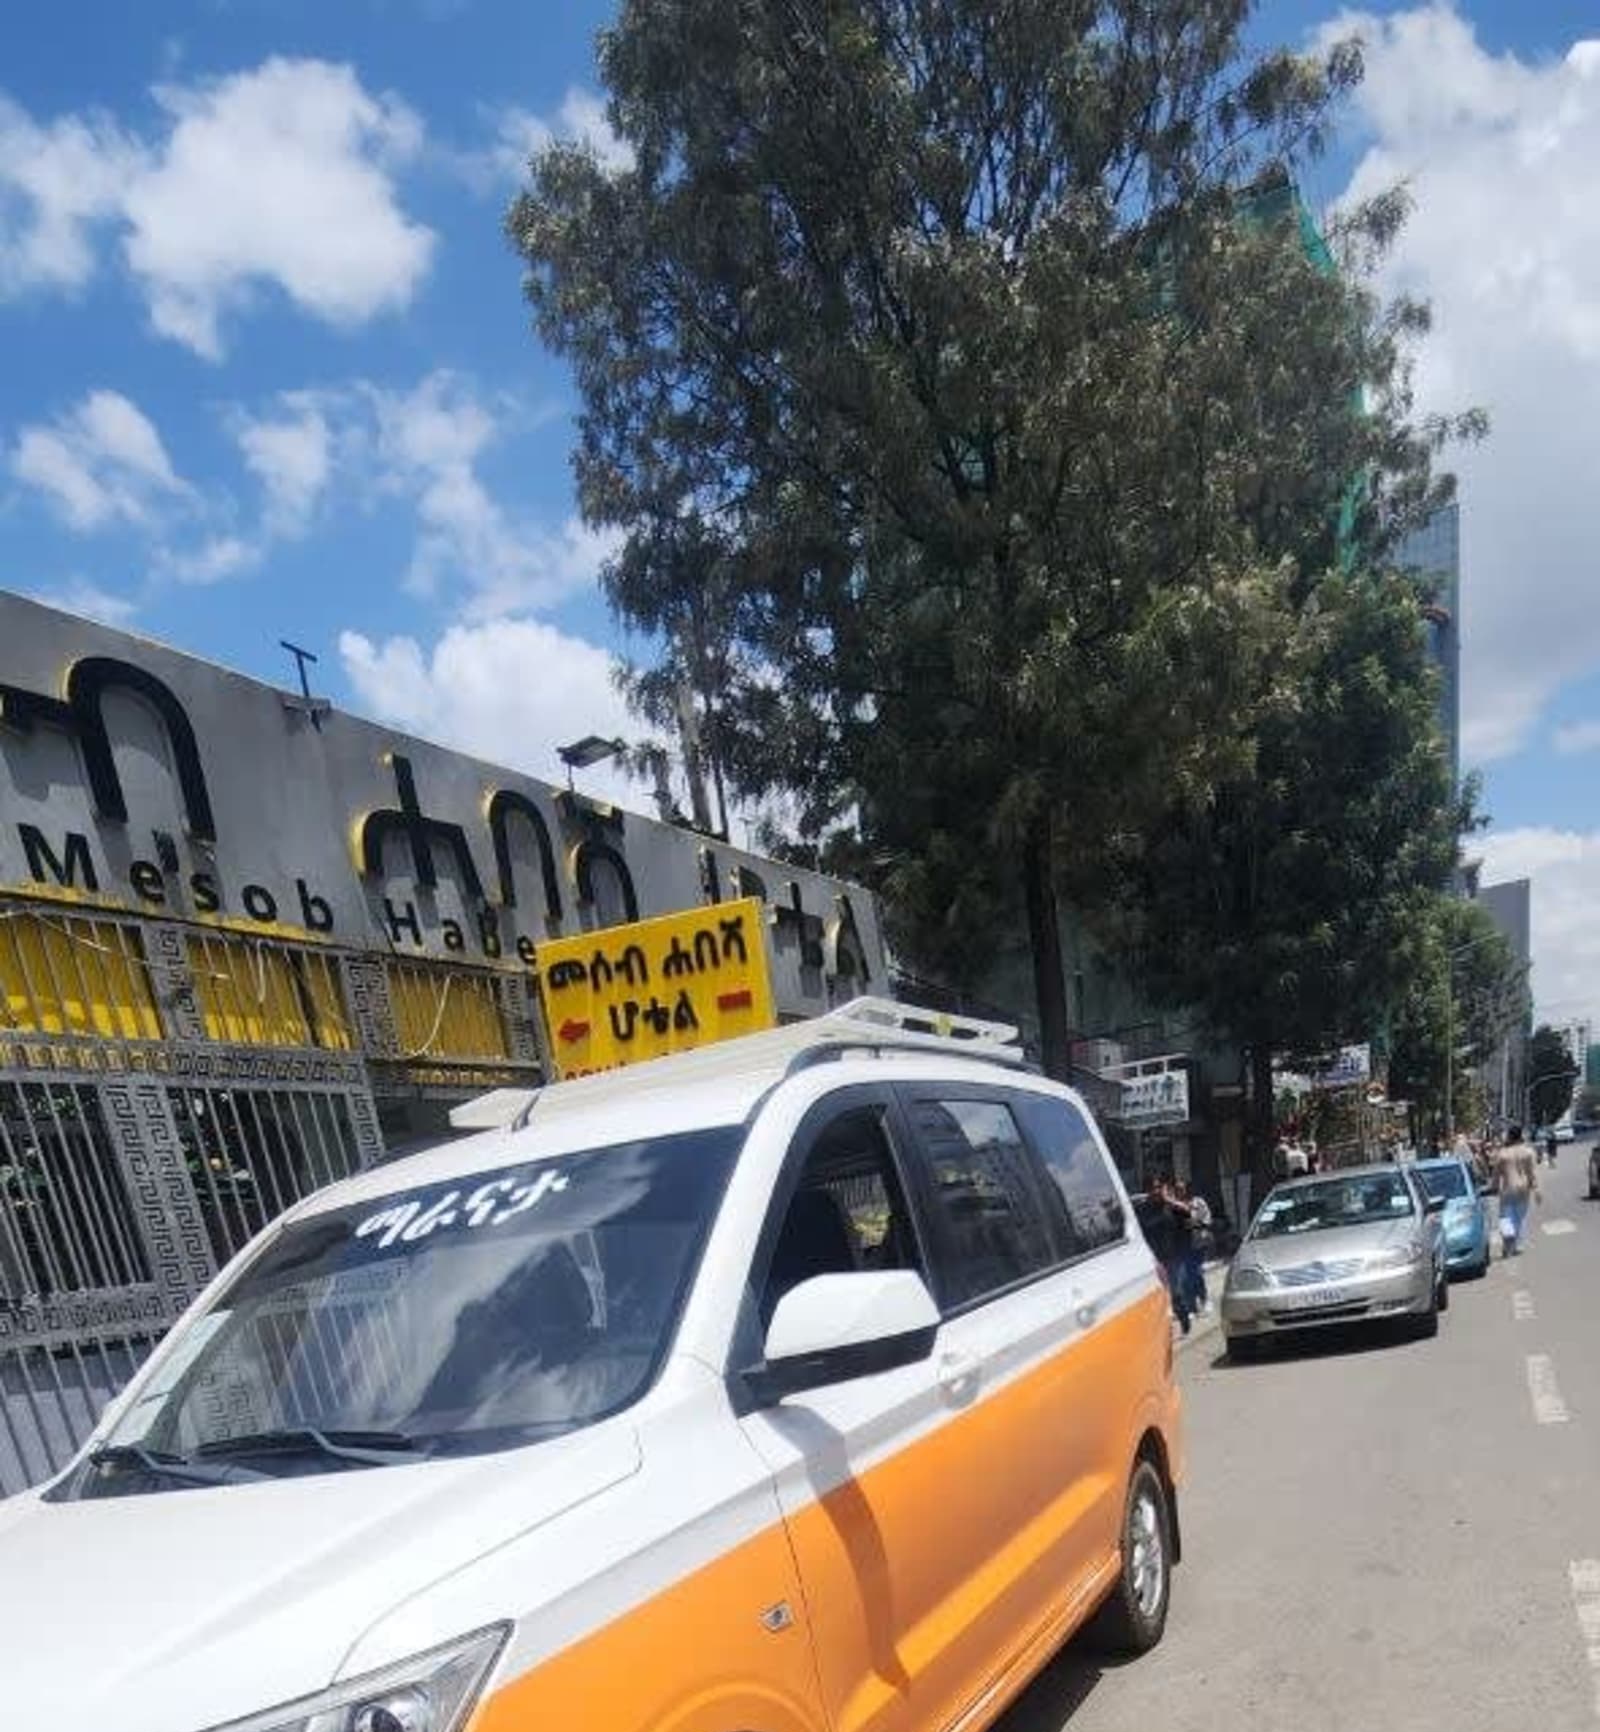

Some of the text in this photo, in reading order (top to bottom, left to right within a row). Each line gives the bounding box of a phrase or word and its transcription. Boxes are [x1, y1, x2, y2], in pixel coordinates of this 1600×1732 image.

[16, 821, 335, 933] Mesob
[547, 944, 648, 991] መሶብ
[608, 989, 700, 1042] ሆቴል
